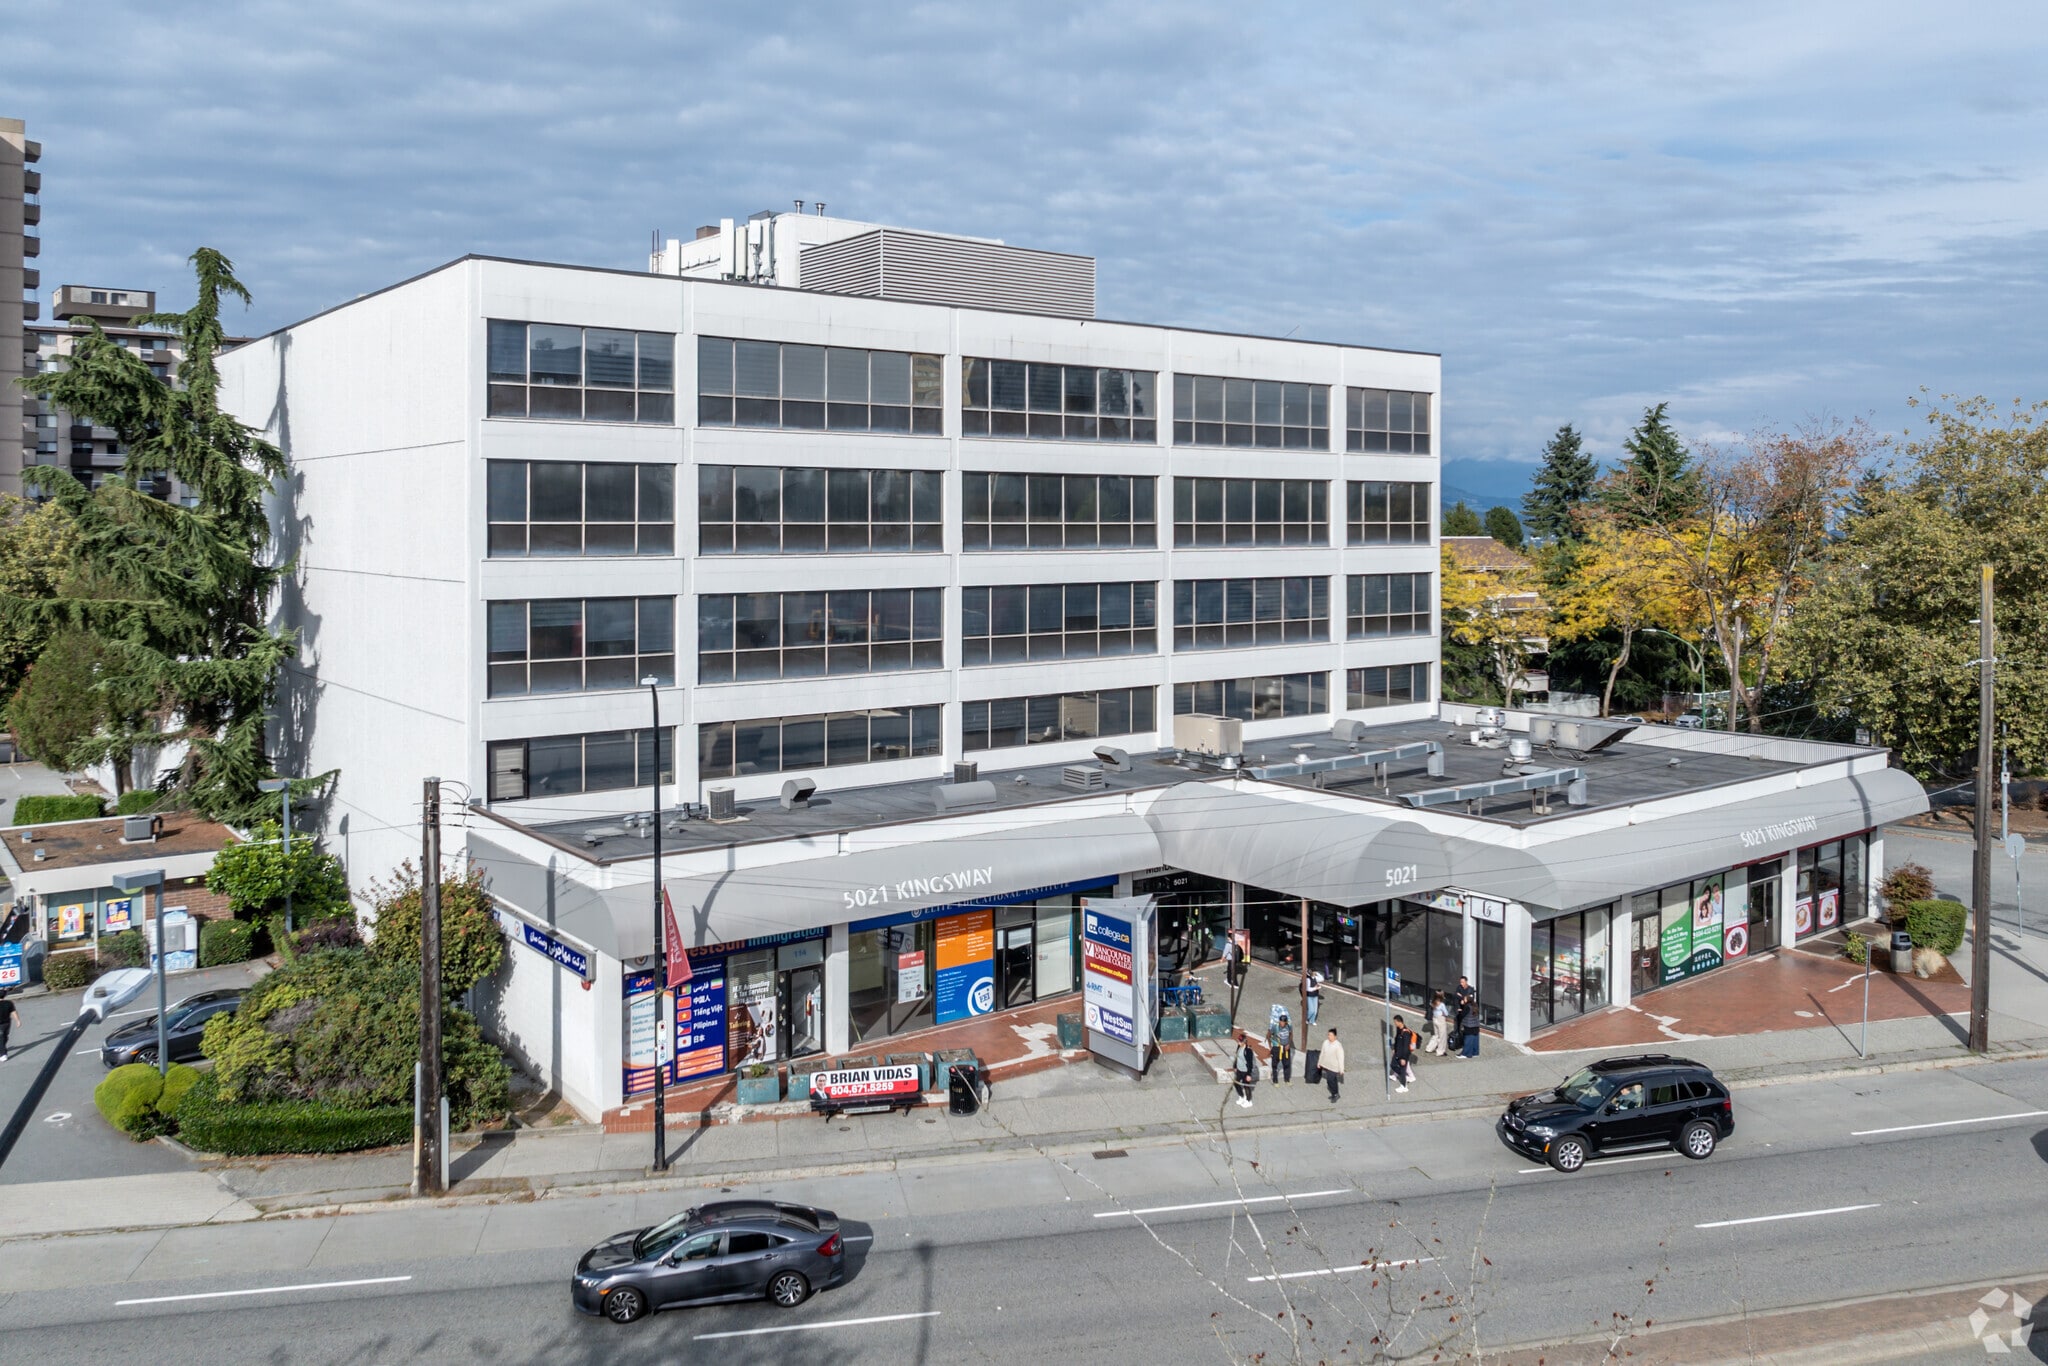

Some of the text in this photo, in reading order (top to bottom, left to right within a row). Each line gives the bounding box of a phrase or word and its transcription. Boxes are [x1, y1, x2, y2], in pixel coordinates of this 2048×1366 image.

[1741, 816, 1818, 848] 5021 KINGSWAY
[1174, 878, 1188, 886] 5021
[1386, 864, 1417, 887] 5021
[844, 867, 993, 909] 5021 KINGSWAY
[1339, 917, 1354, 927] OPEN
[686, 939, 745, 957] estSun
[1095, 945, 1132, 962] VANCOUVER
[1095, 952, 1132, 971] CAREER COLLEGE
[693, 982, 709, 993] فارسی
[1103, 1010, 1132, 1030] WestSun
[1103, 1021, 1132, 1038] Immigration
[831, 1067, 912, 1084] BRIAN VIDAS
[831, 1082, 894, 1096] 604.671.5259
